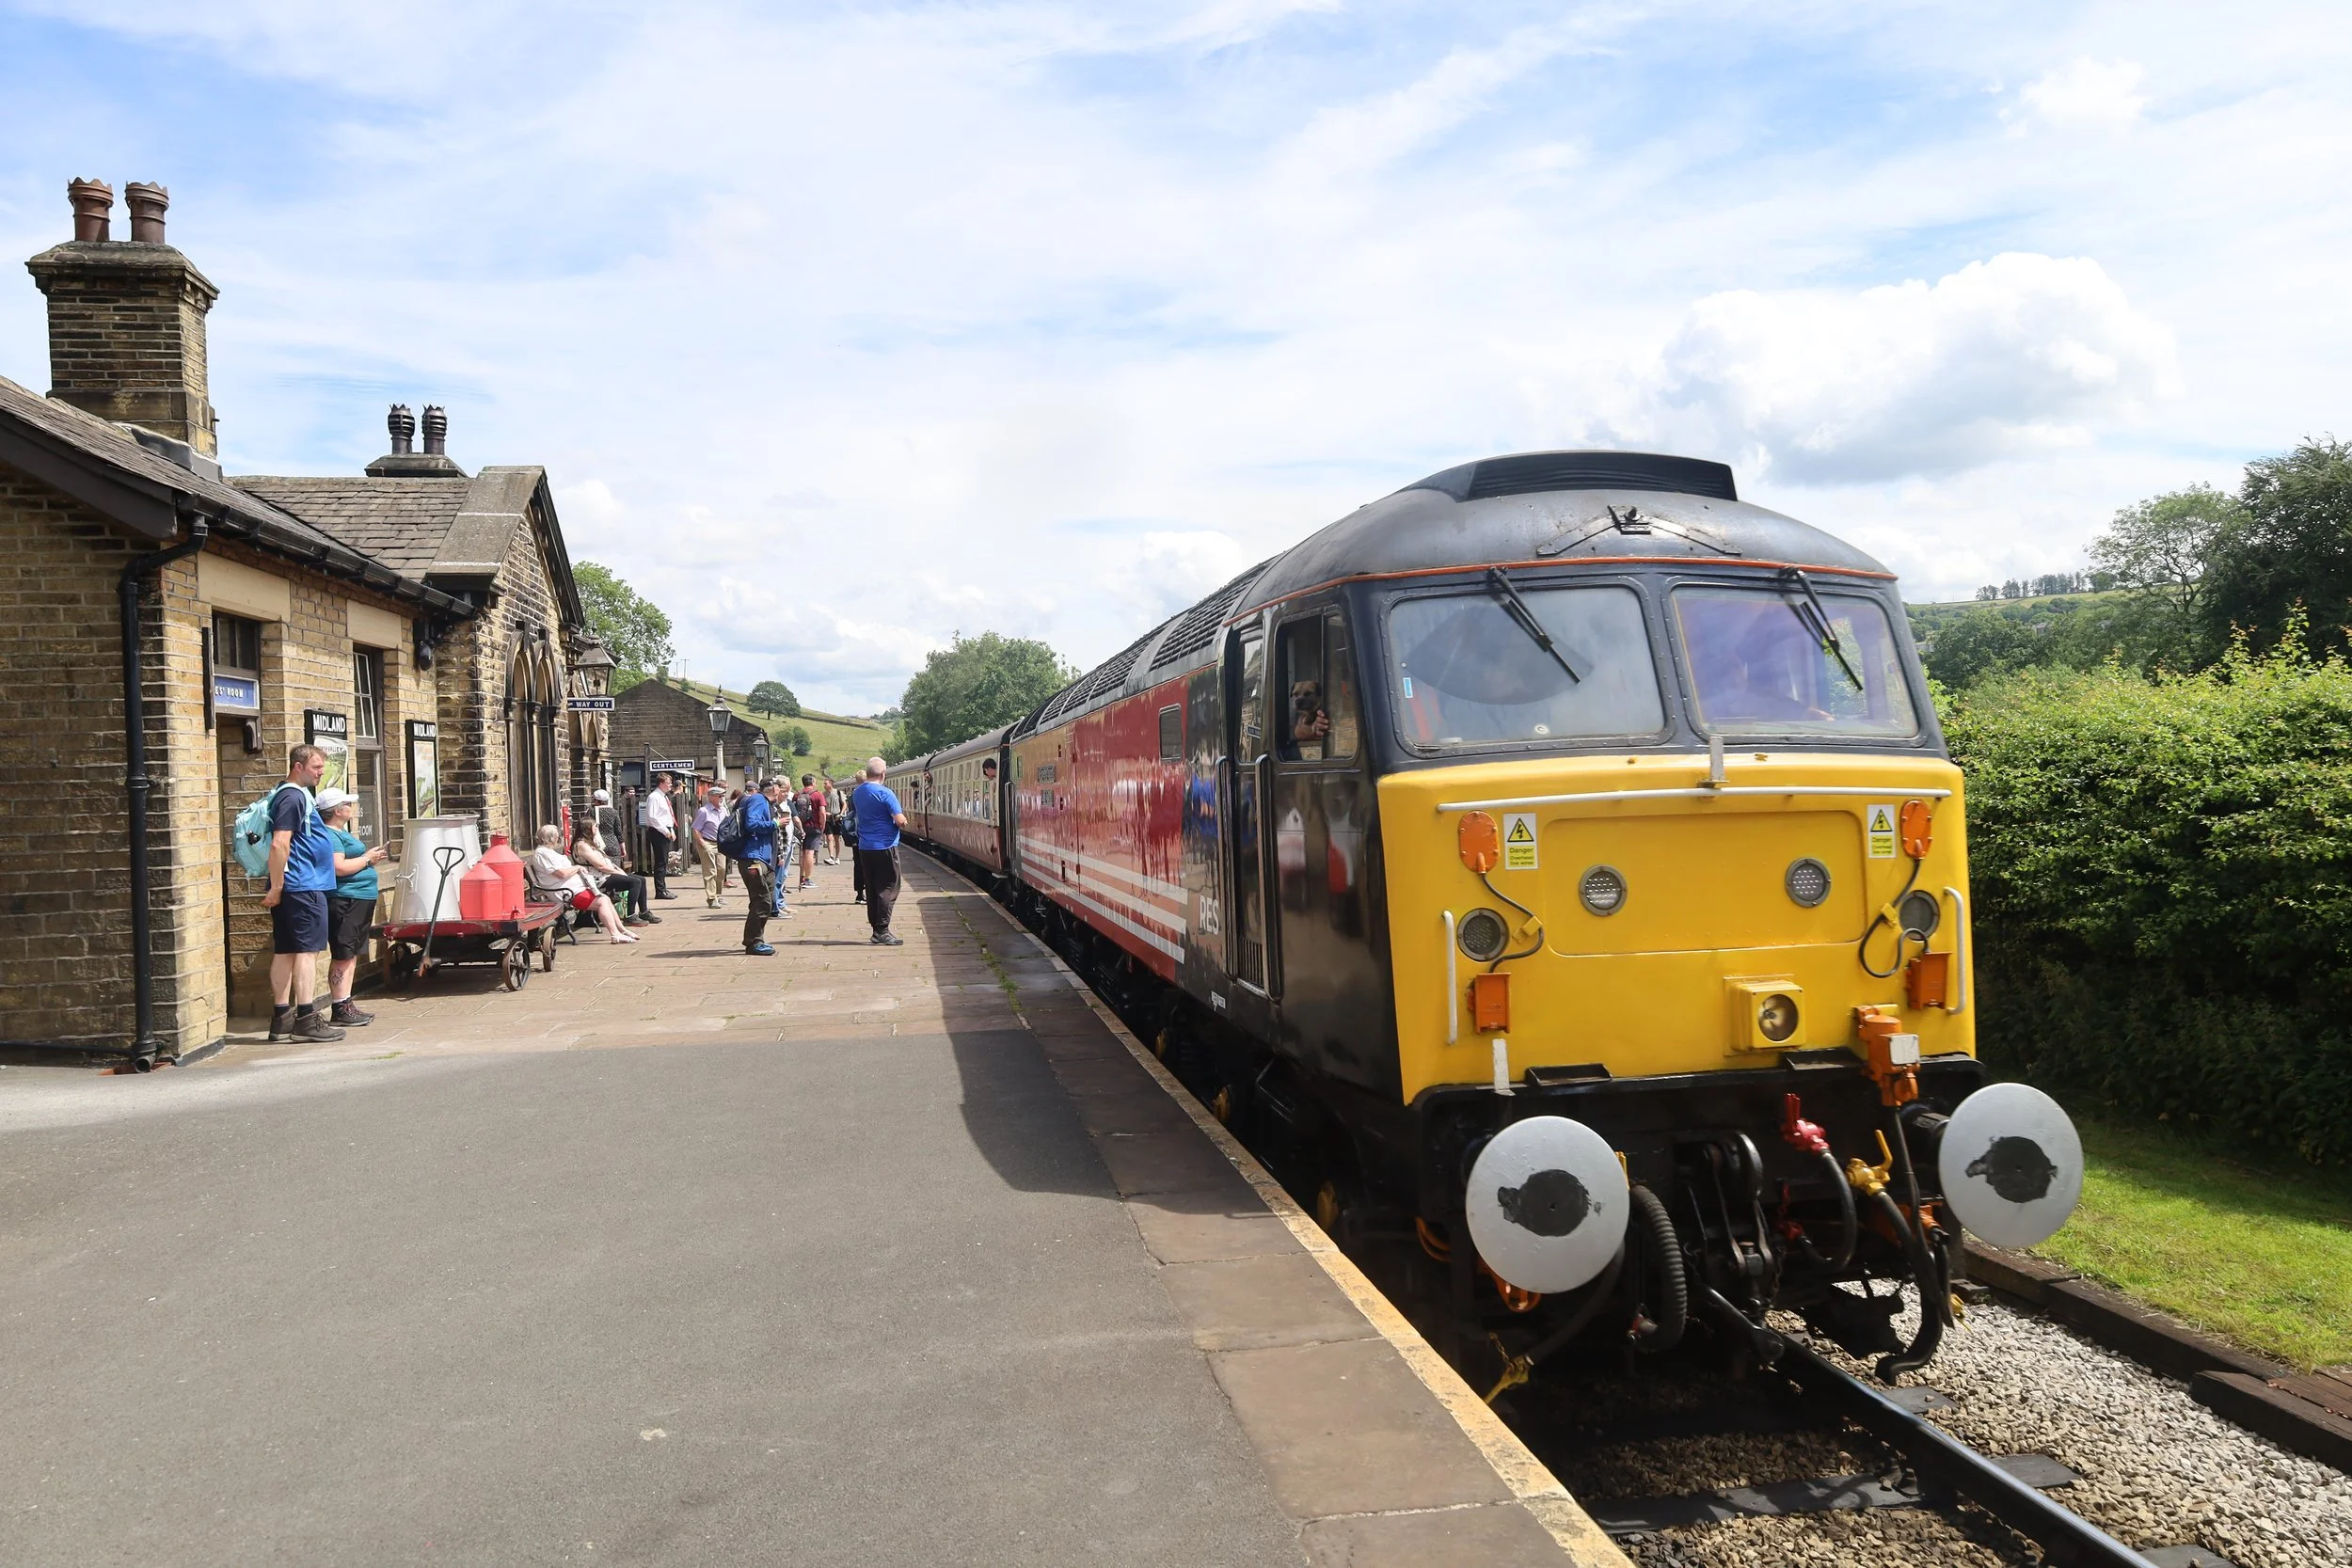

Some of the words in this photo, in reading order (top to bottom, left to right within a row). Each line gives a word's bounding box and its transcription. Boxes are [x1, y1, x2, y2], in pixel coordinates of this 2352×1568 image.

[227, 687, 244, 699] ROOM
[312, 713, 345, 733] MIDLAND
[413, 722, 437, 737] MIDLAND
[1200, 895, 1219, 935] RES
